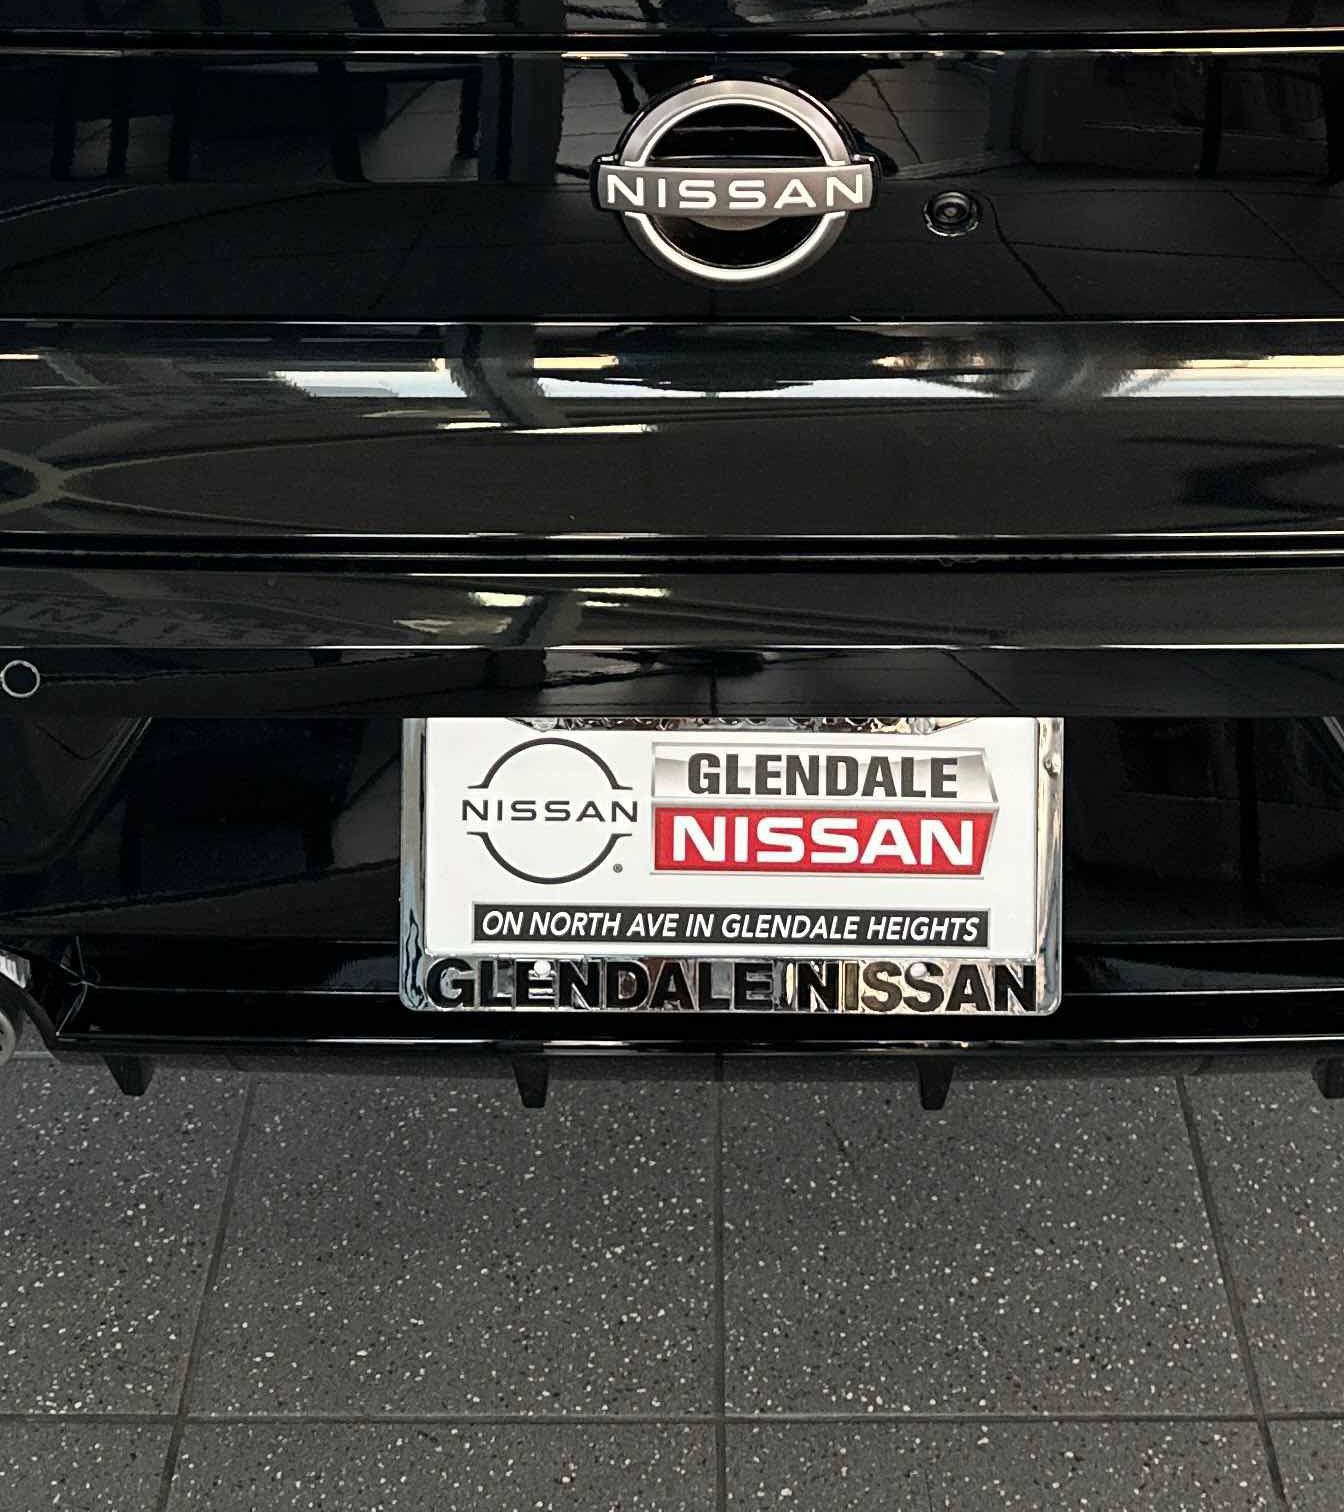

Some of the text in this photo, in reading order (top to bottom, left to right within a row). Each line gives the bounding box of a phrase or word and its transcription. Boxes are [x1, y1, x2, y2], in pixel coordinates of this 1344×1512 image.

[607, 174, 864, 210] NISSAN
[687, 752, 959, 798] GLENDALE
[461, 799, 638, 823] NISSAN
[672, 815, 975, 866] NISSAN
[482, 910, 980, 941] ON NORTH AVE IN GLENDALE HEIGHTS
[425, 958, 1037, 1012] GLENDALE NISSAN
